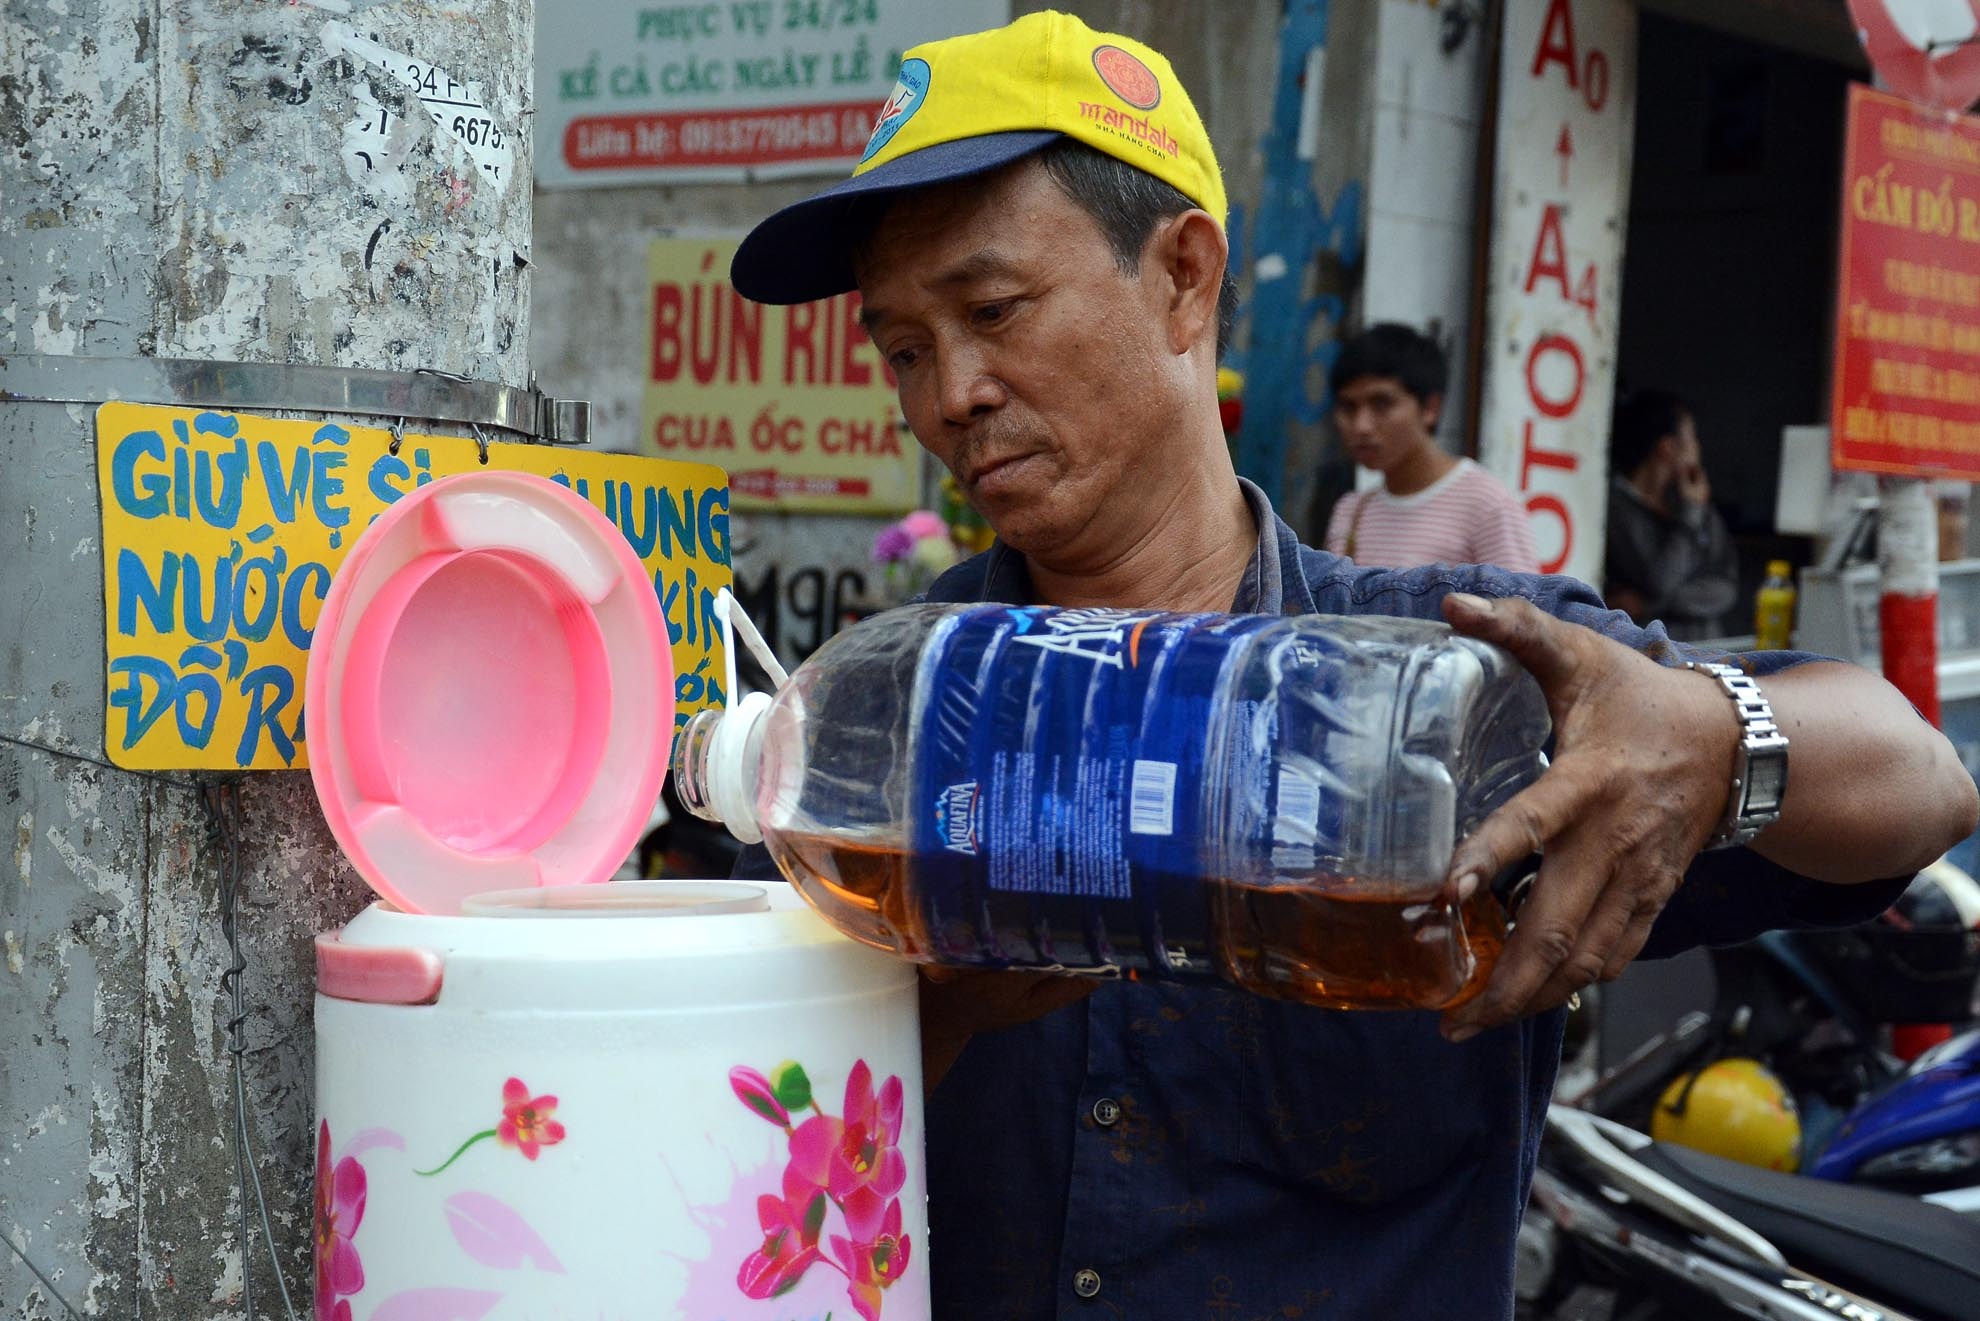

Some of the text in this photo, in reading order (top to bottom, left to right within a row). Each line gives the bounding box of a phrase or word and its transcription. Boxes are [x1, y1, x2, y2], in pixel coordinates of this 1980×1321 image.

[1078, 101, 1179, 160] mandala
[653, 251, 763, 386] BÚN
[655, 414, 737, 450] CUA
[112, 411, 250, 529] GIỮ
[257, 423, 351, 550] VỆ
[944, 779, 978, 857] AQUAFINA
